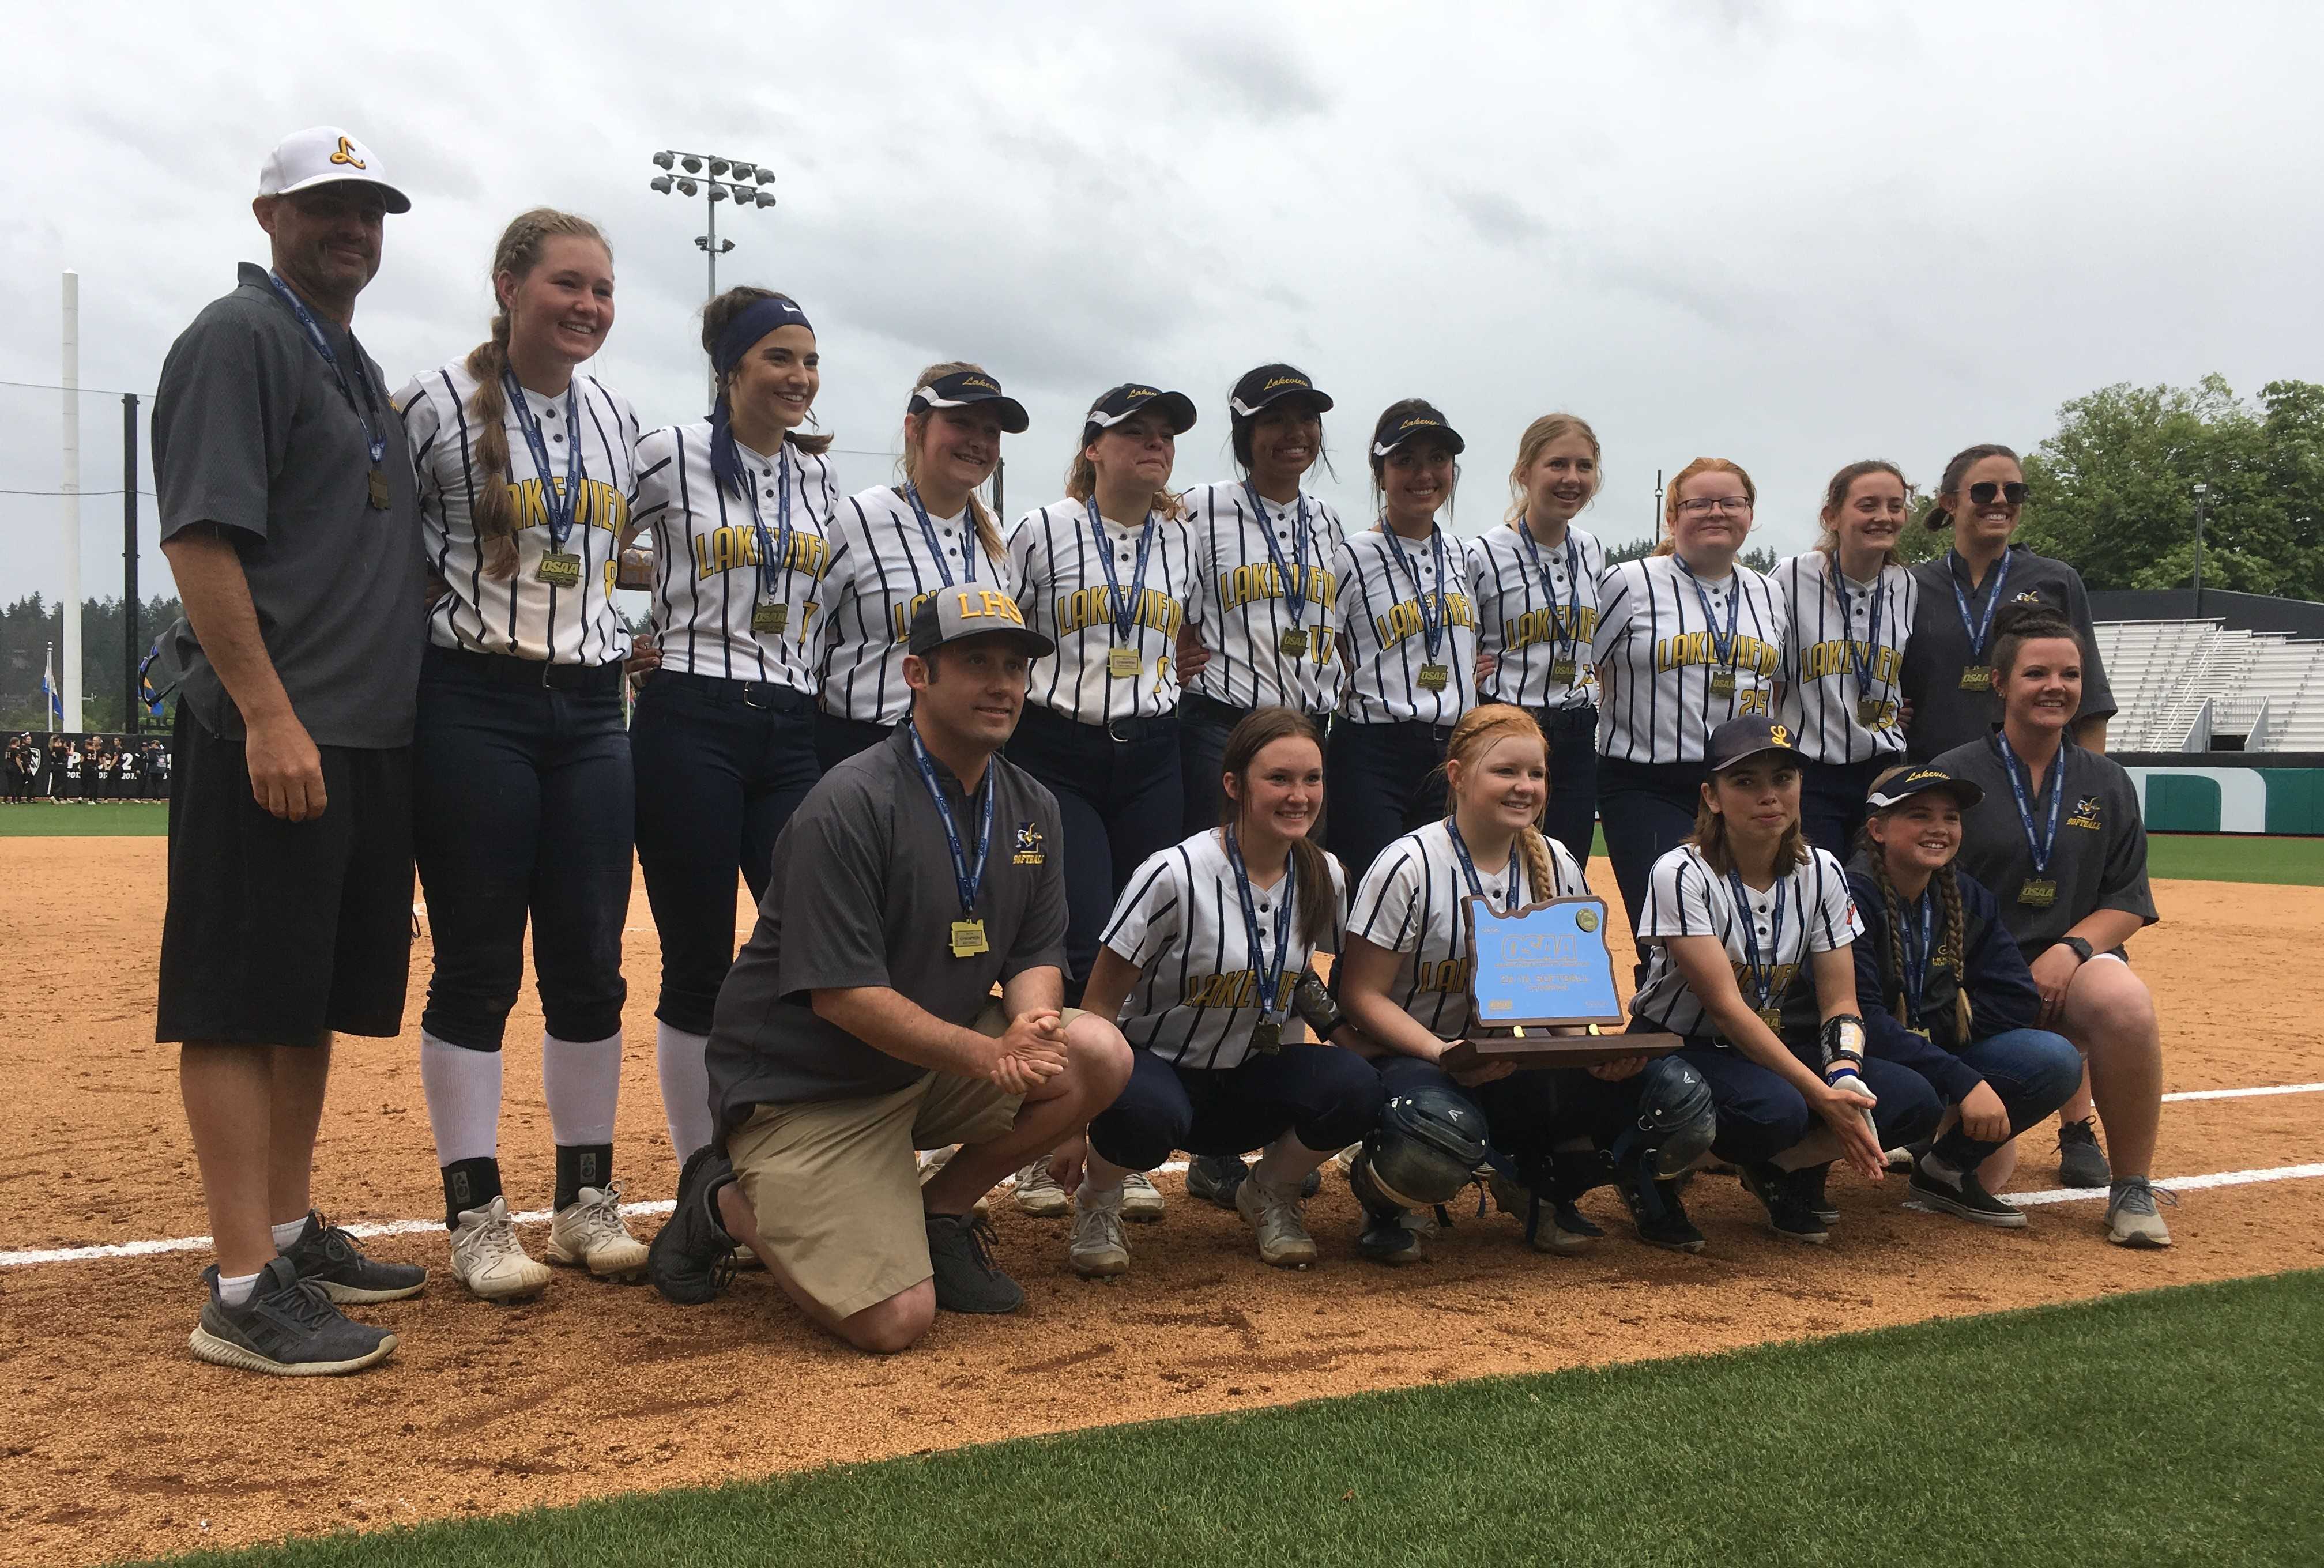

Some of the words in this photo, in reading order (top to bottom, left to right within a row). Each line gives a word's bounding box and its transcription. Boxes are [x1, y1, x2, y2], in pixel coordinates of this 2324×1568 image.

[541, 560, 580, 575] OSAA
[1221, 563, 1337, 615] LAKEVEW
[755, 612, 786, 623] OSAA
[958, 590, 1022, 625] LHS
[797, 600, 820, 644] 7
[1377, 593, 1476, 651] LAKVIE
[1506, 605, 1600, 652] LAKEVIE
[1284, 636, 1307, 647] OSAA
[1309, 625, 1334, 665] 17
[1801, 640, 1903, 688] LAKEVEW
[1421, 670, 1447, 681] OSAA
[1963, 674, 1988, 683] OSAA
[2066, 817, 2102, 830] SOFTBALL
[1012, 854, 1045, 865] SOFTBALL
[2022, 887, 2054, 897] OSAA
[1502, 933, 1577, 962] OSAA
